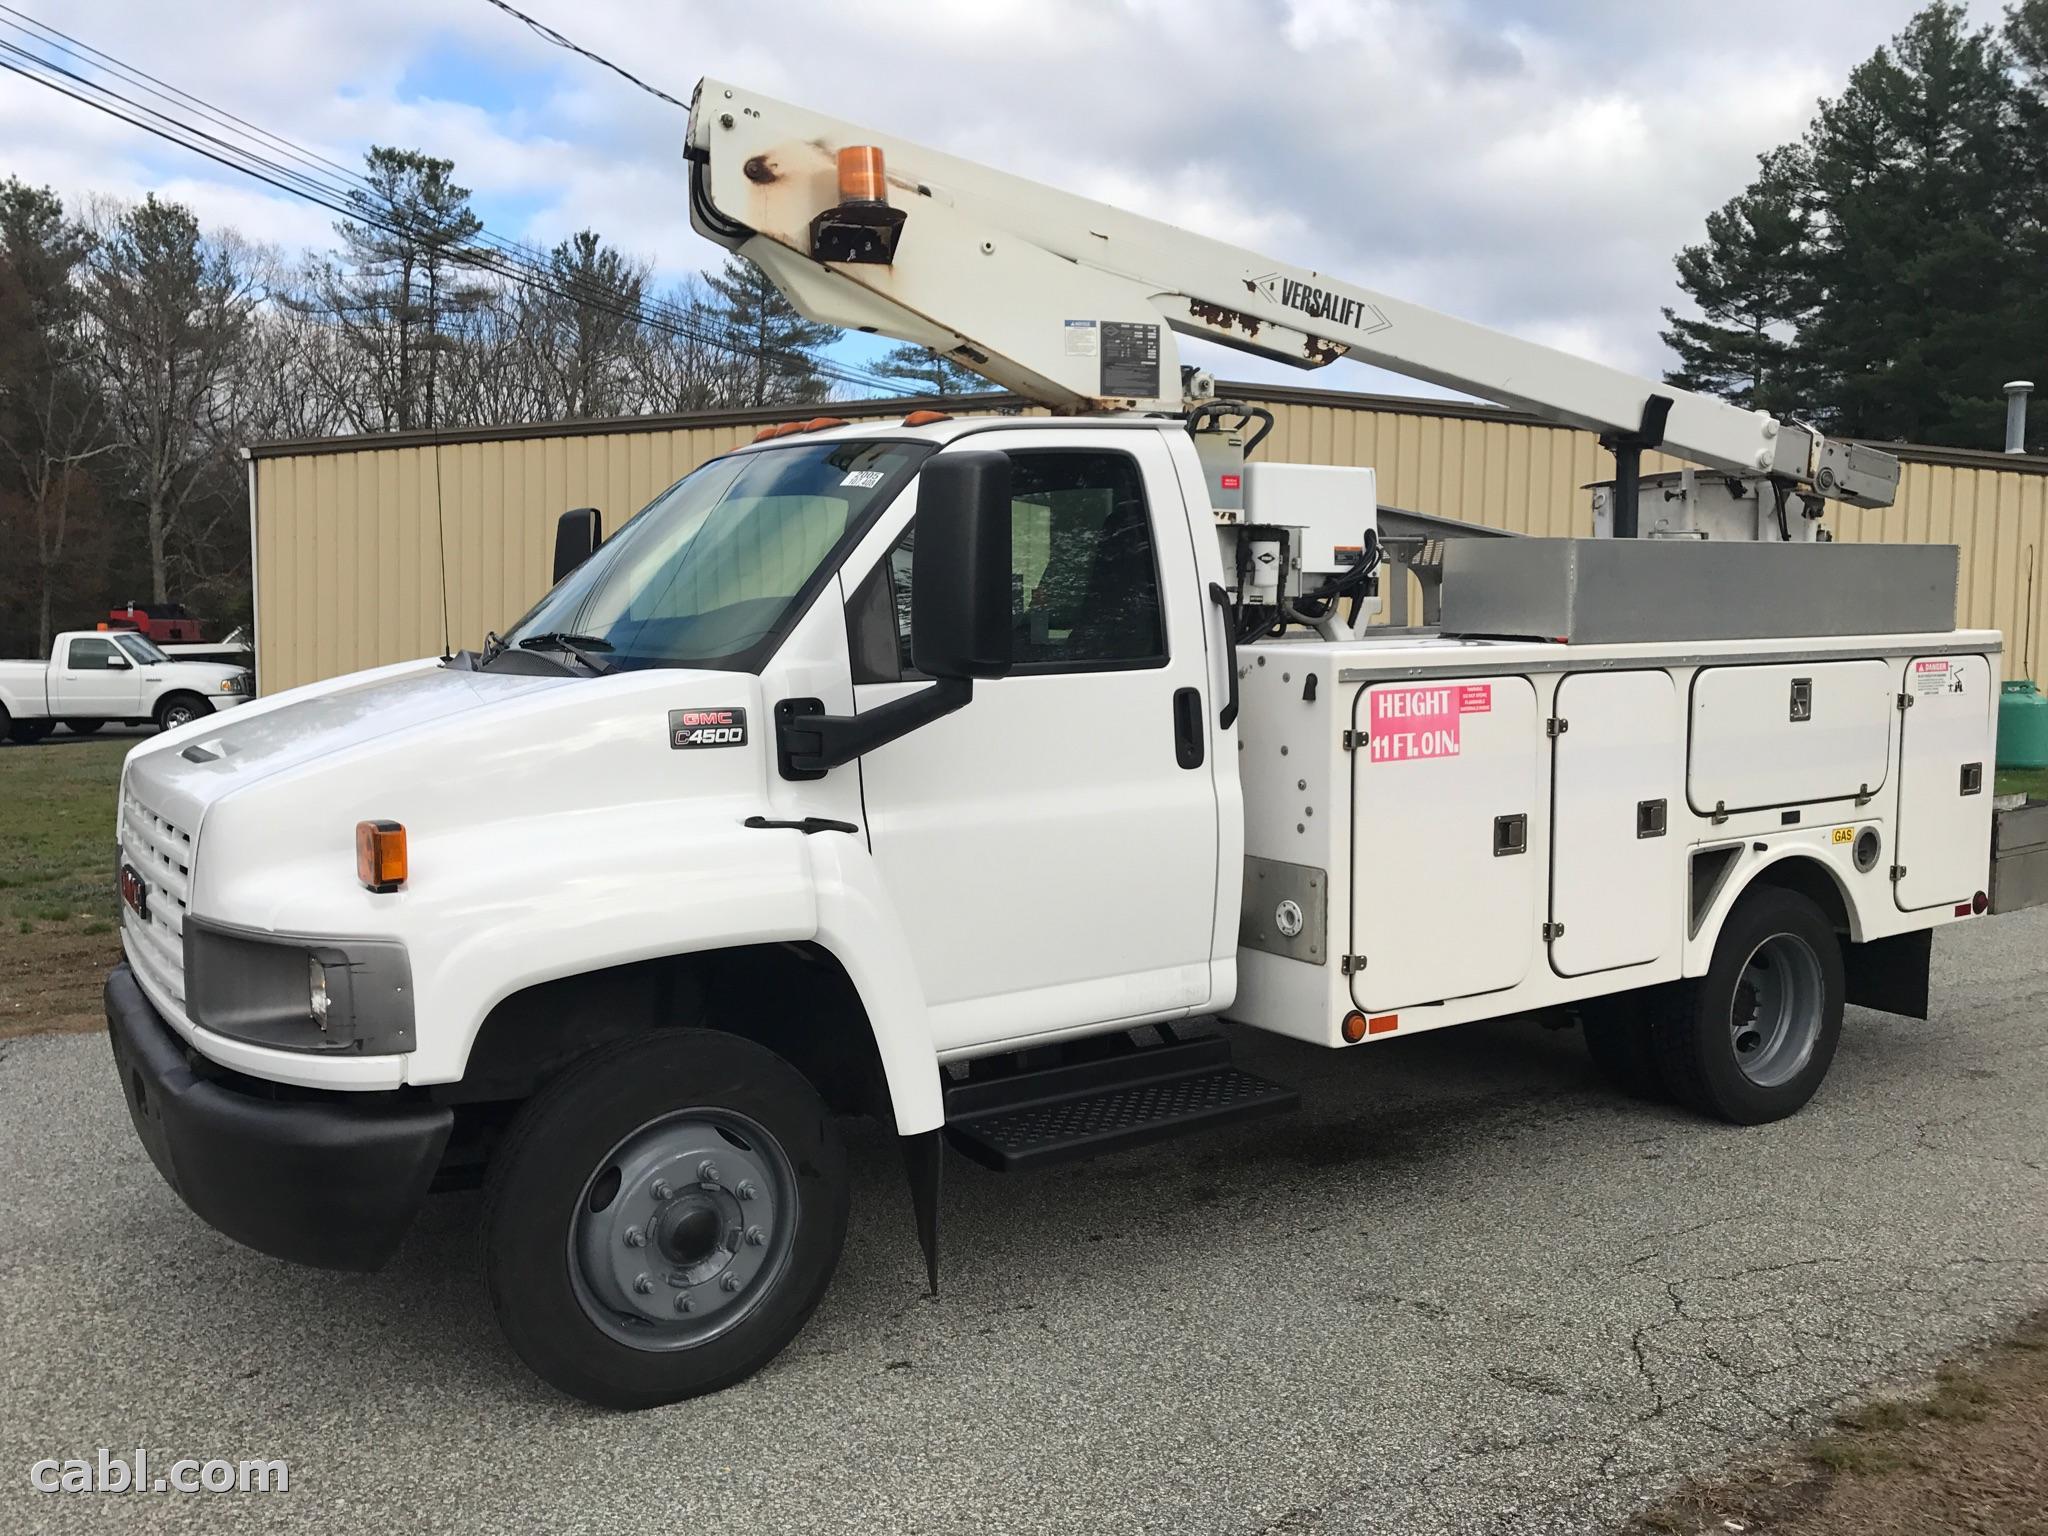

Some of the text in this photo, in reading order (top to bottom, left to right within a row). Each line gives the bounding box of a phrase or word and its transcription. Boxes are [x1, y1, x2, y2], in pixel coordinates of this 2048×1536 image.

[1281, 278, 1365, 328] VERSALIFT
[1925, 663, 1947, 671] DANGER
[1378, 690, 1451, 719] HEIGHT
[683, 712, 732, 726] GMC
[675, 727, 743, 745] C4500
[1372, 735, 1389, 759] 11
[1393, 732, 1419, 758] FT.
[1834, 829, 1852, 842] GAS
